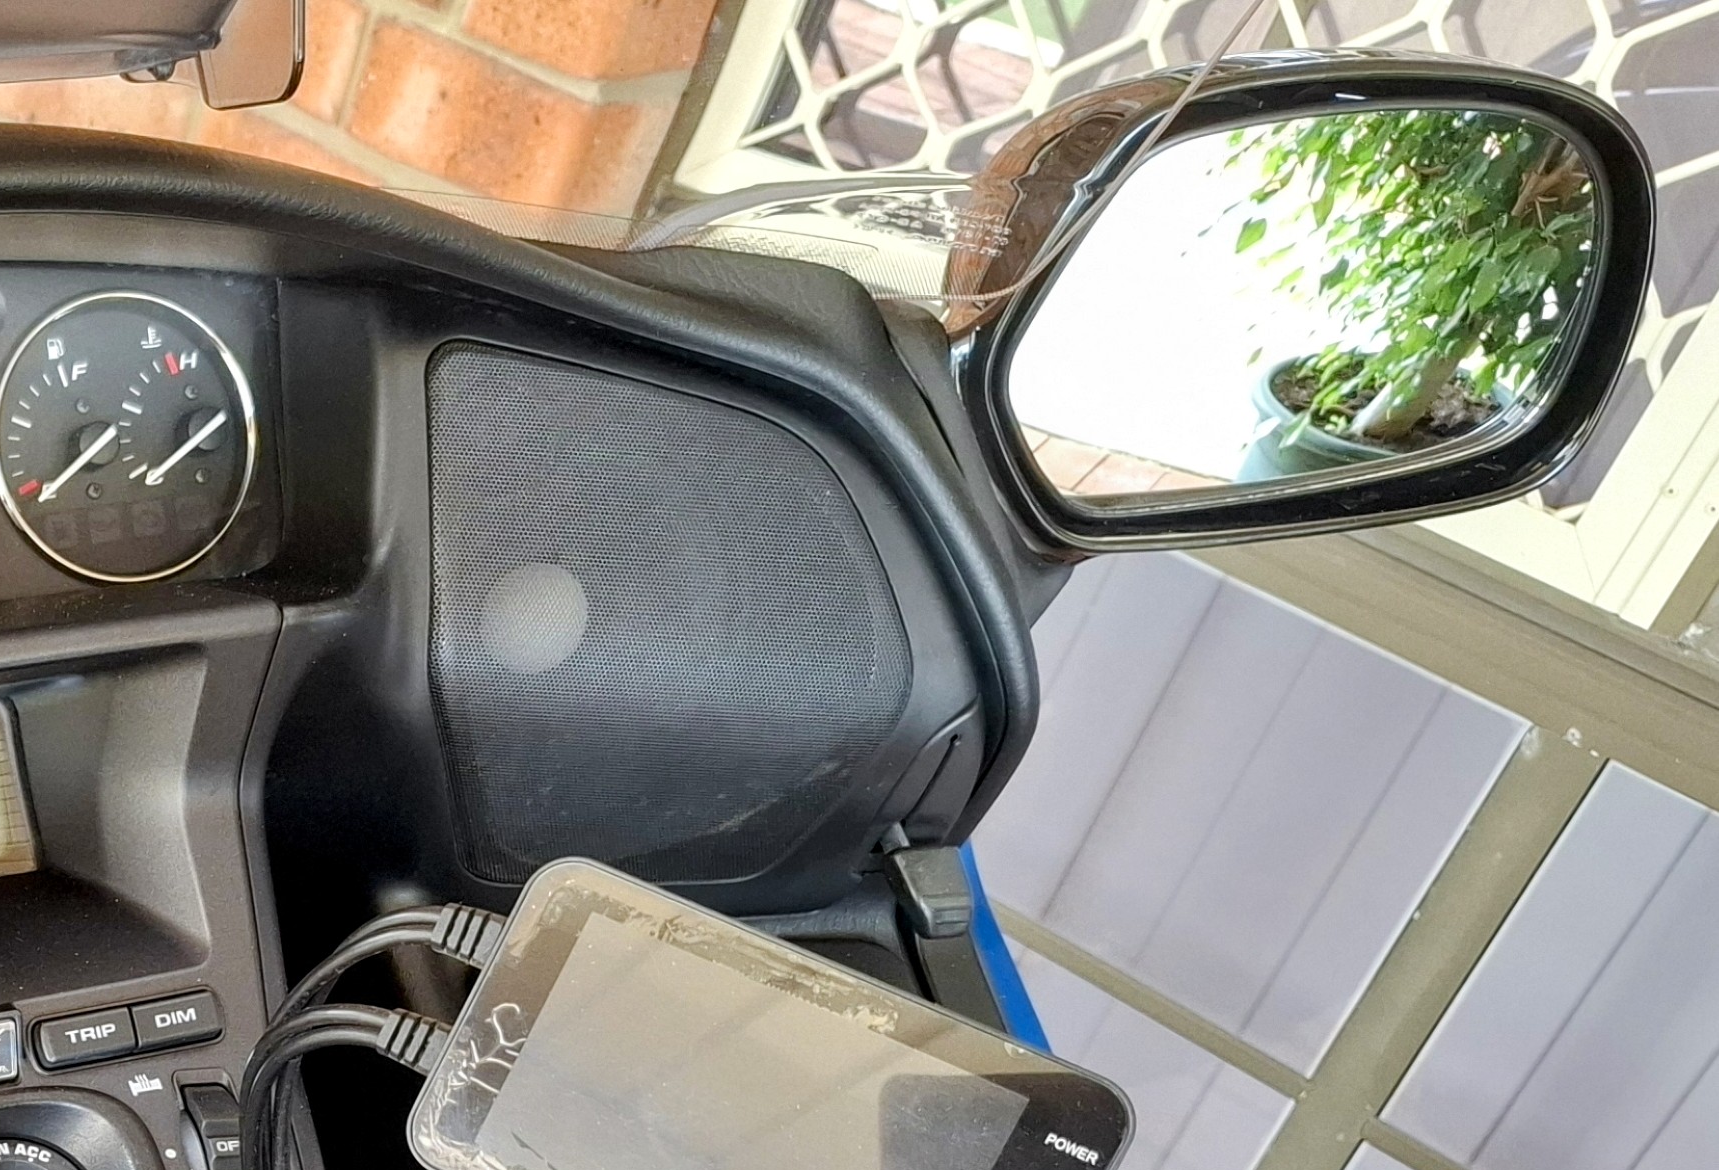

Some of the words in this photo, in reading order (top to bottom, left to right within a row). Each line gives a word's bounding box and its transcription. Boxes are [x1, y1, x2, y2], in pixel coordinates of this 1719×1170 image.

[72, 361, 88, 381] F
[179, 352, 198, 370] H
[64, 1023, 116, 1045] TRIP
[154, 1007, 197, 1029] DIM
[14, 1143, 51, 1163] ACC
[216, 1140, 240, 1152] OF
[1043, 1132, 1099, 1166] POWER
